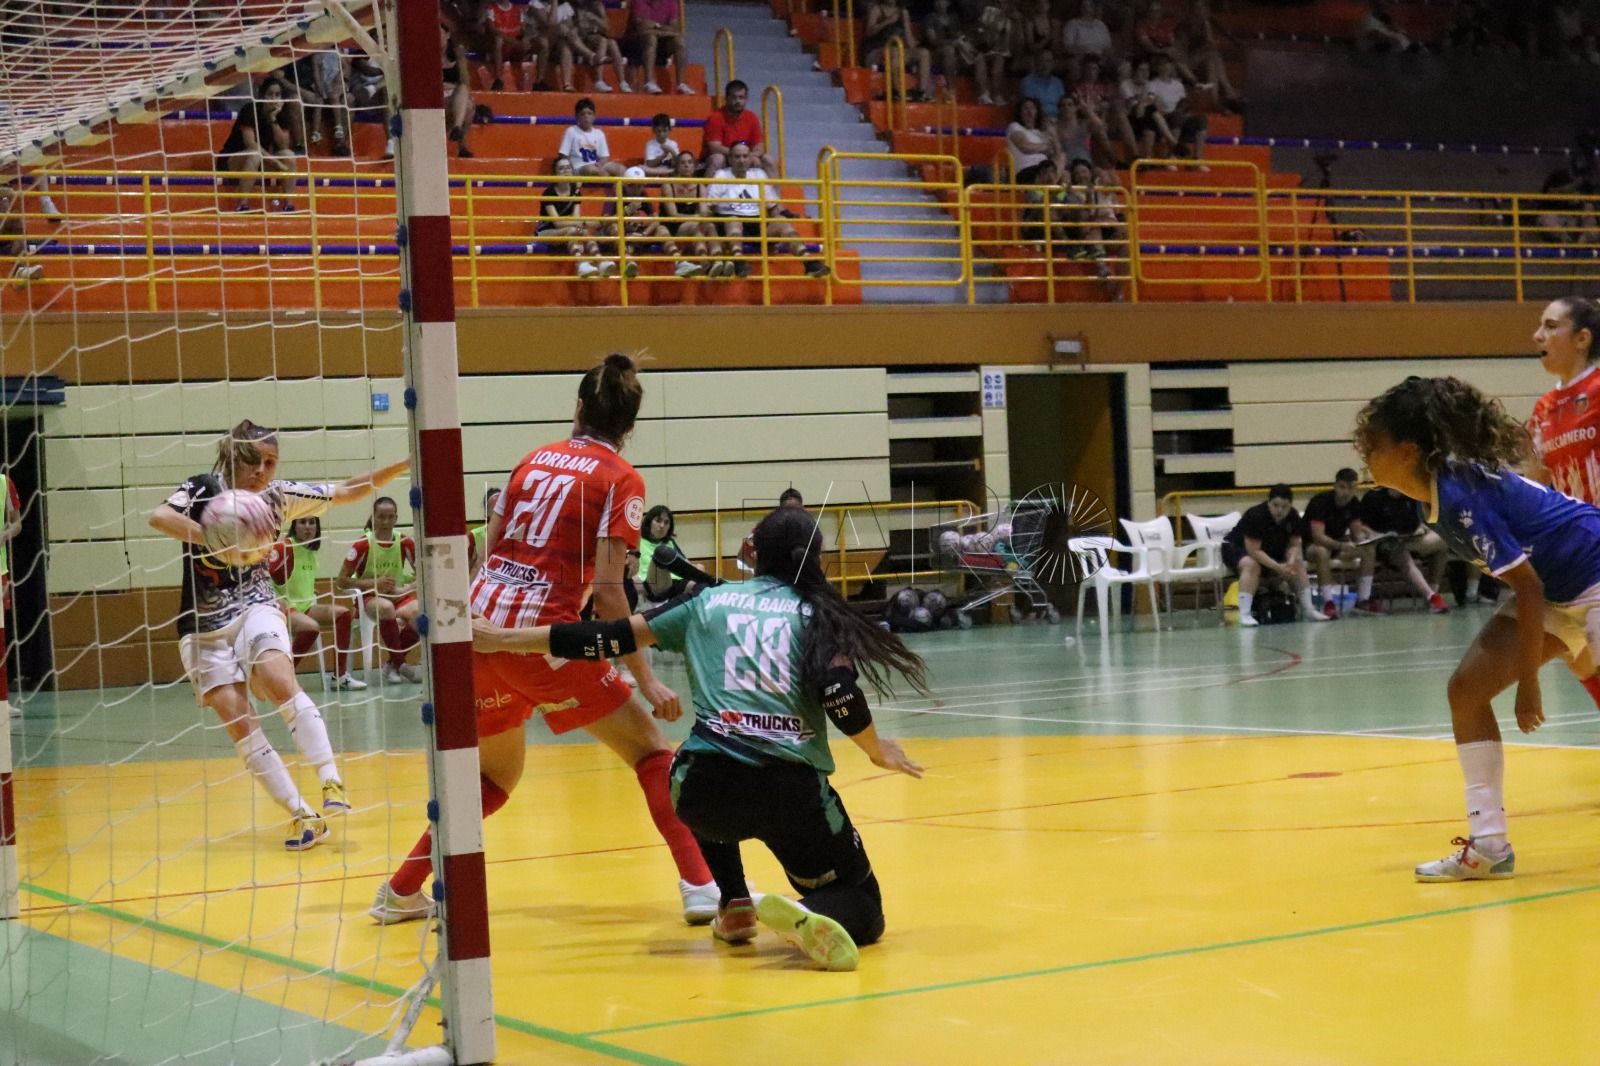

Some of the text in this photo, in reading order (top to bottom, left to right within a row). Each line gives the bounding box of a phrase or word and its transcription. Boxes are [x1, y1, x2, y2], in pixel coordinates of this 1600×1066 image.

[530, 451, 600, 475] LORRANA
[503, 469, 577, 548] 20
[501, 560, 537, 582] TRUCKS
[584, 646, 596, 657] 28
[724, 613, 791, 693] 28
[742, 713, 801, 733] TRUCKS
[834, 706, 849, 719] 28
